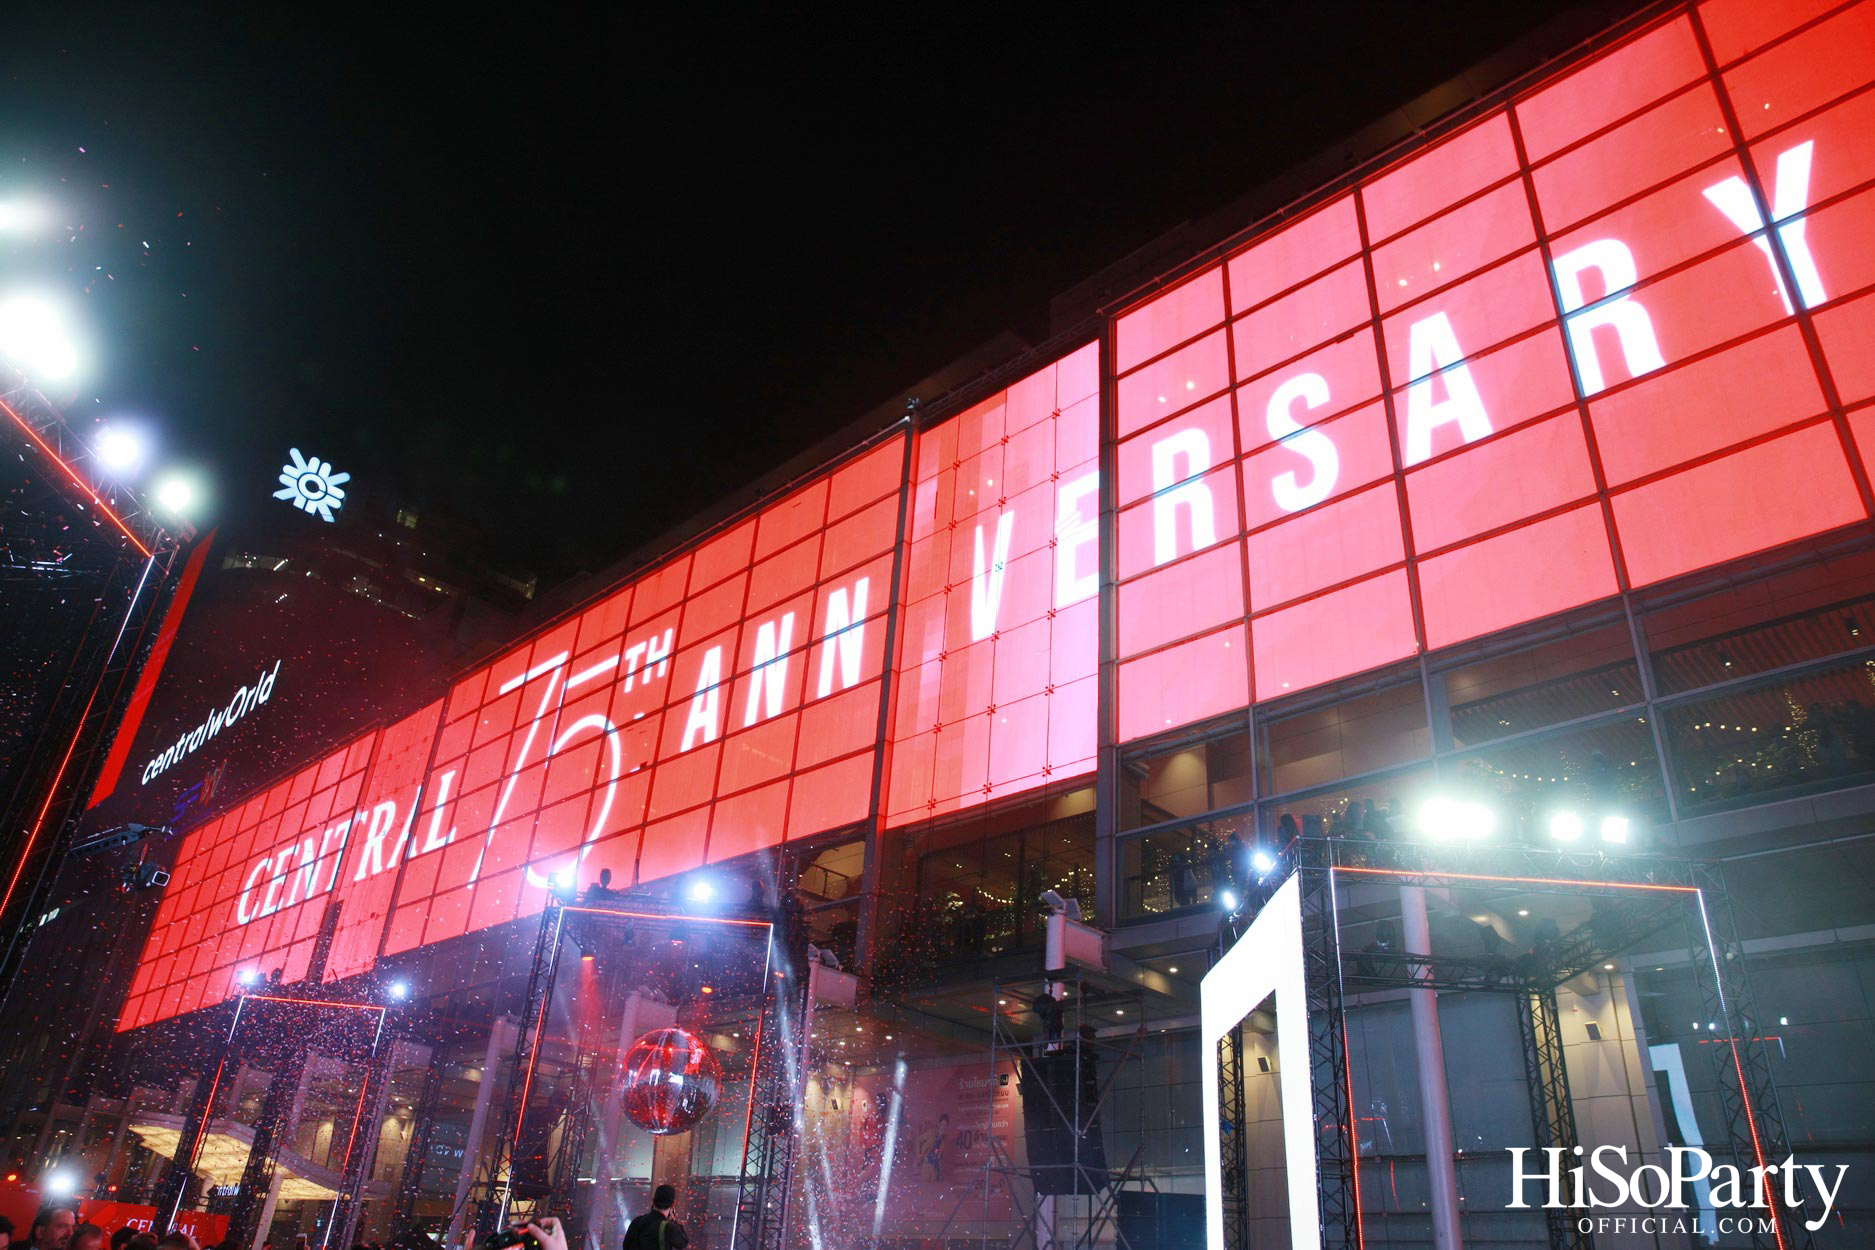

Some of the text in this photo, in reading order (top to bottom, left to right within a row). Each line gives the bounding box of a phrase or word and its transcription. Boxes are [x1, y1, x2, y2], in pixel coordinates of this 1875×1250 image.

[141, 659, 281, 785] centralwOrld
[237, 770, 456, 925] CENTRAL
[681, 139, 1827, 753] ANNVERSARY
